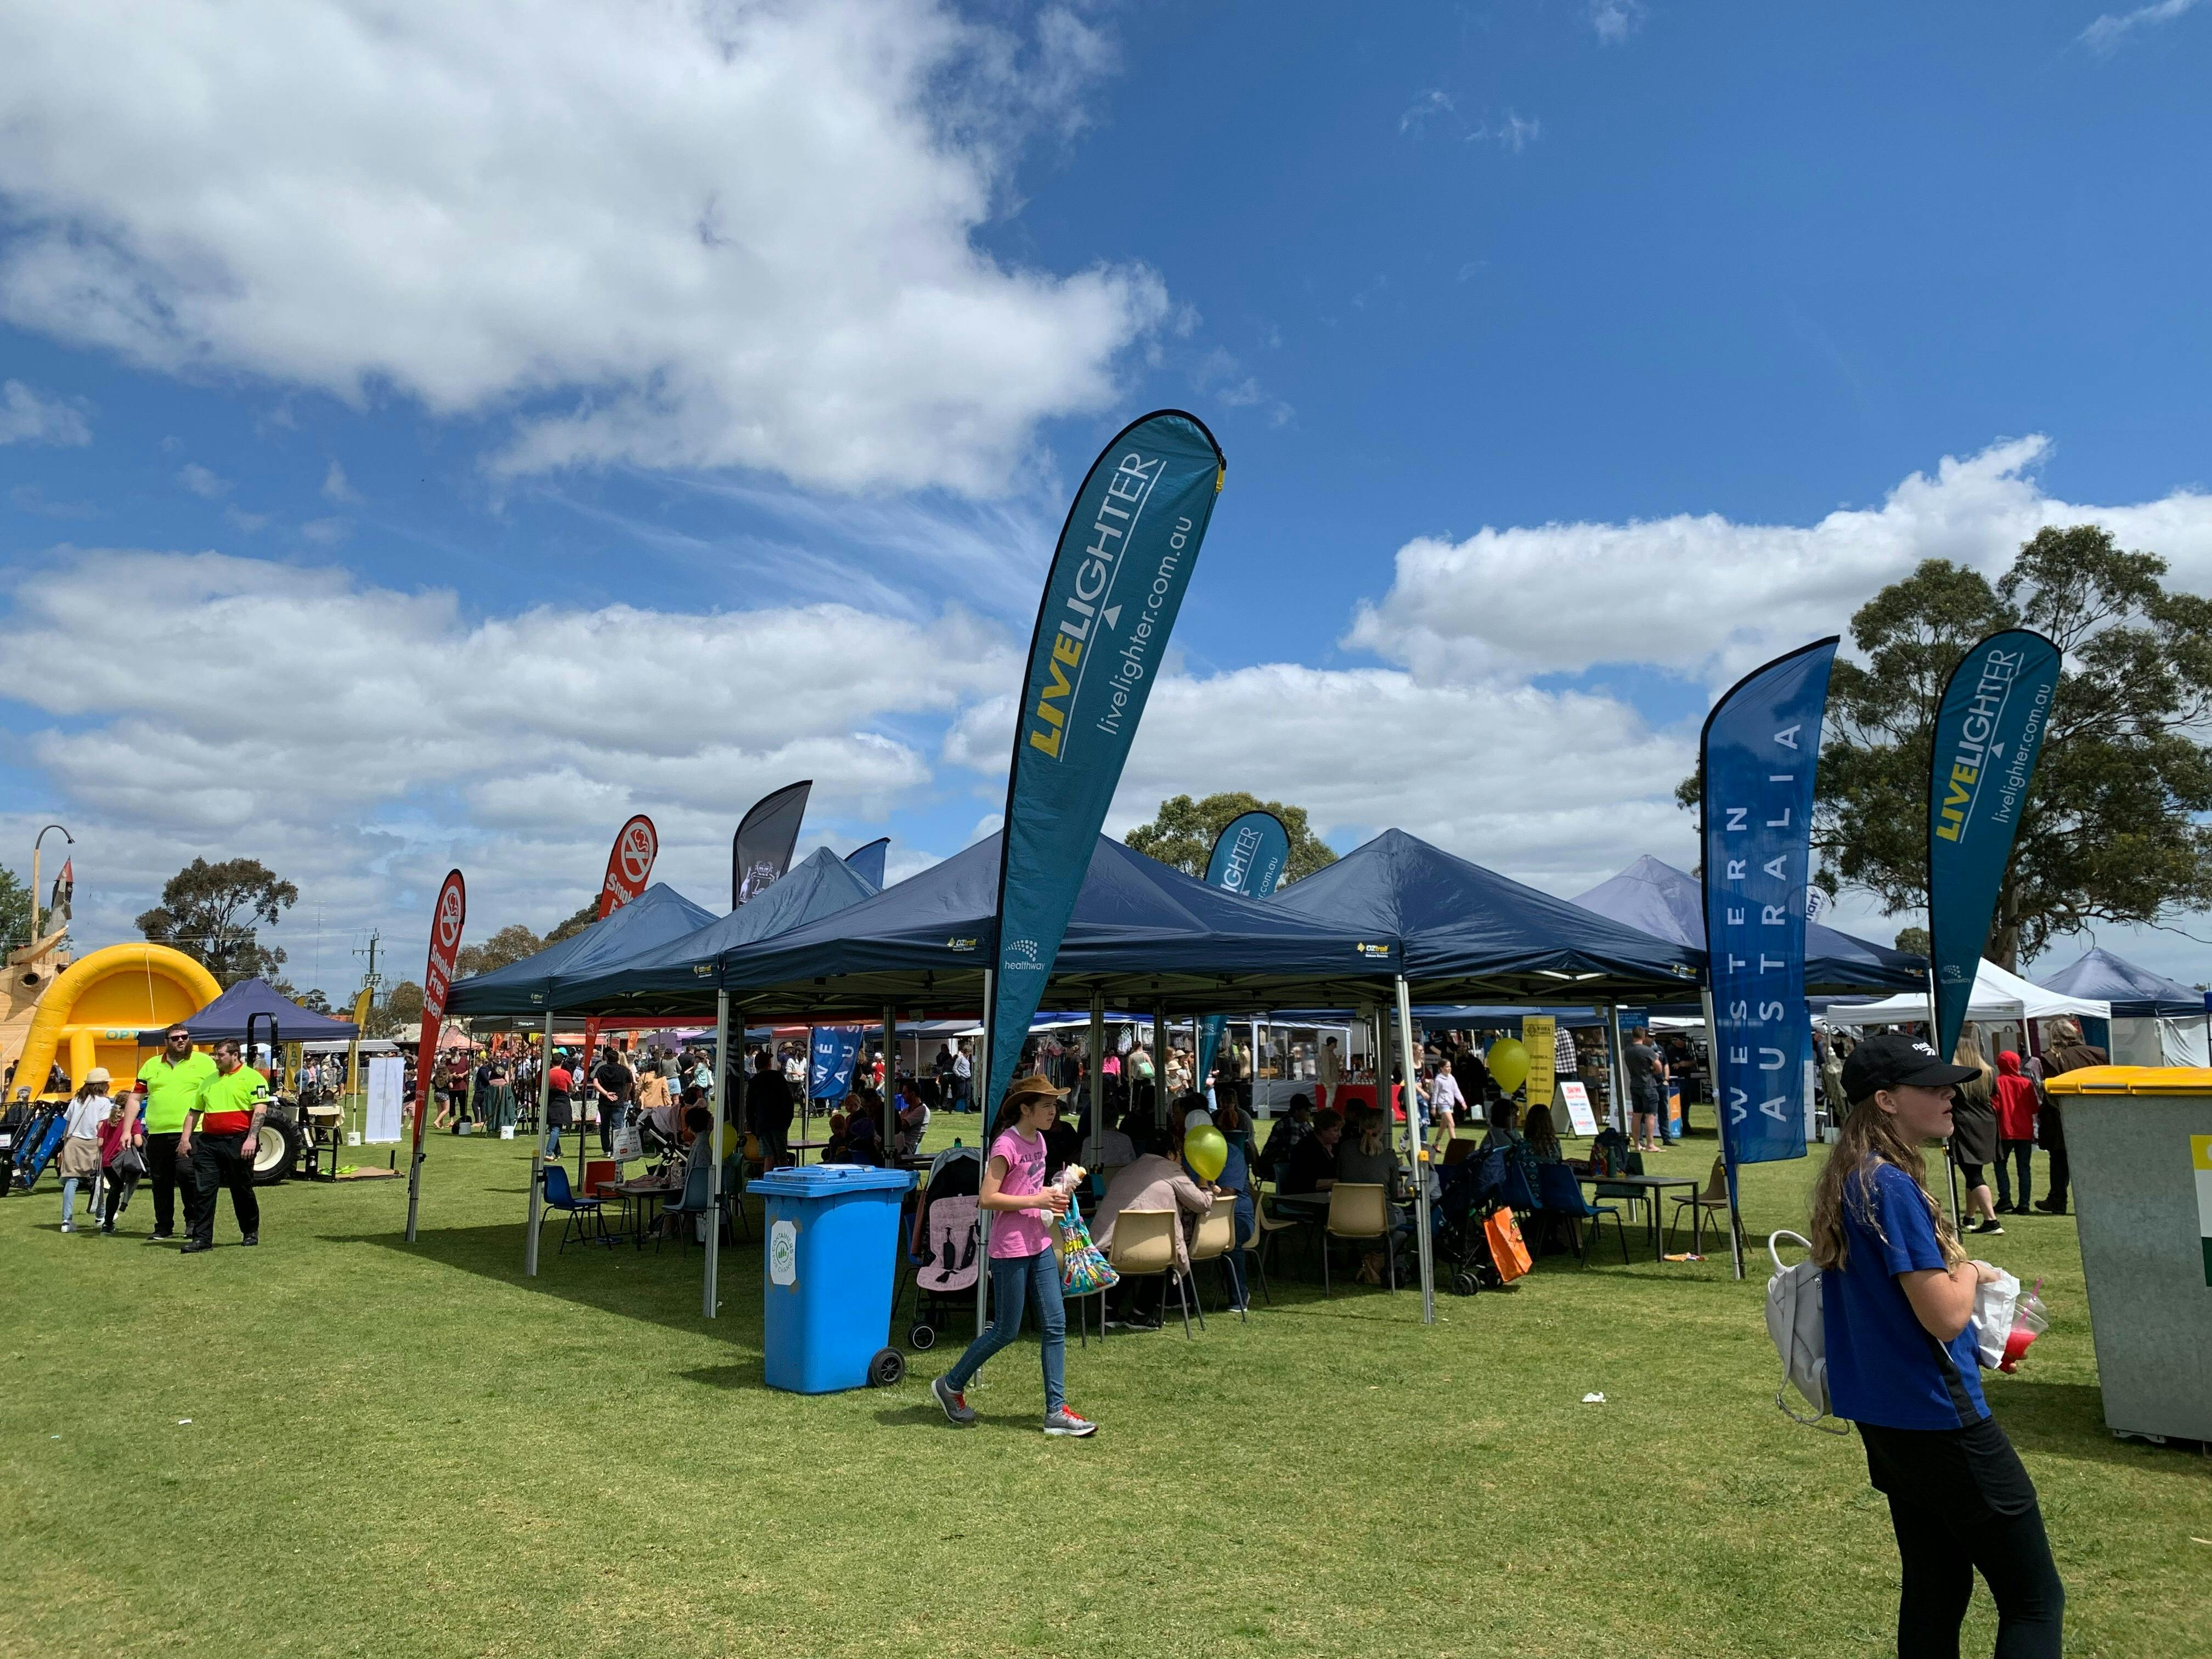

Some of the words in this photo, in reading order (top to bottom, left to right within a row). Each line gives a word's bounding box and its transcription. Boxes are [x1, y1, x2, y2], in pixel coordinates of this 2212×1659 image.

[1029, 453, 1159, 759] LIVELIGHTER
[1097, 516, 1193, 735] livelighter.com.au
[1936, 649, 2018, 842] LIVELIGHTER
[1991, 684, 2051, 823] livelighter.com.au
[428, 968, 444, 1000] Free
[431, 943, 452, 983] Smoke
[1005, 961, 1046, 971] healthway
[1726, 807, 1748, 1125] WESTERN
[1758, 724, 1801, 1123] AUSTRALIA
[1019, 1154, 1034, 1164] ALL
